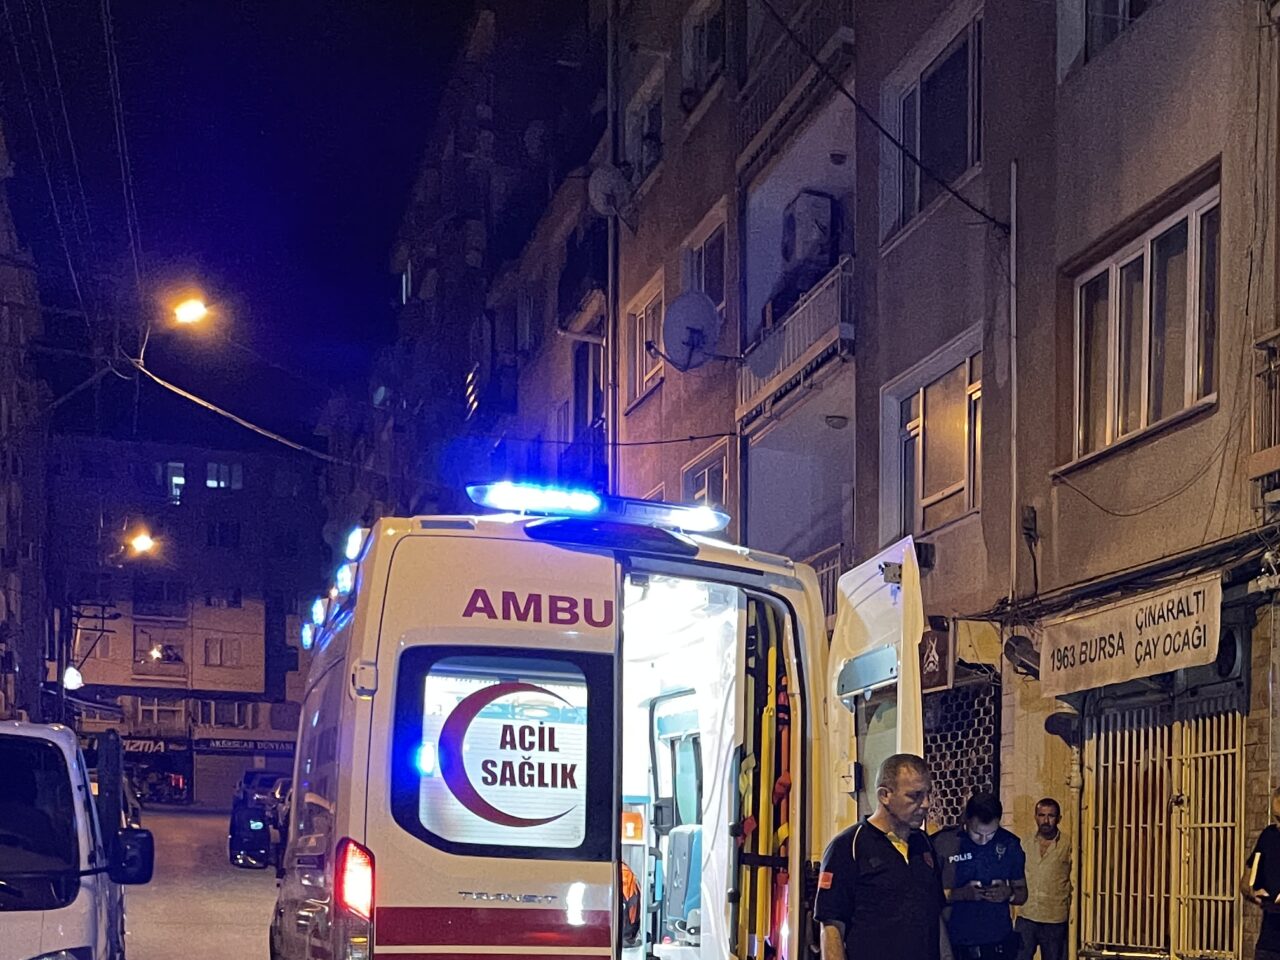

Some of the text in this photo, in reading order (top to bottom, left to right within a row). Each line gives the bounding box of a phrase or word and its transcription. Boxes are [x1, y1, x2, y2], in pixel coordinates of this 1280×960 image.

[462, 588, 614, 628] AMBU
[1135, 589, 1206, 636] ÇINARALTI
[1050, 631, 1125, 672] 1963 BURSA
[1134, 621, 1207, 668] ÇAY OCAĞI
[499, 721, 560, 752] ACİL
[481, 756, 578, 789] SAĞLIK
